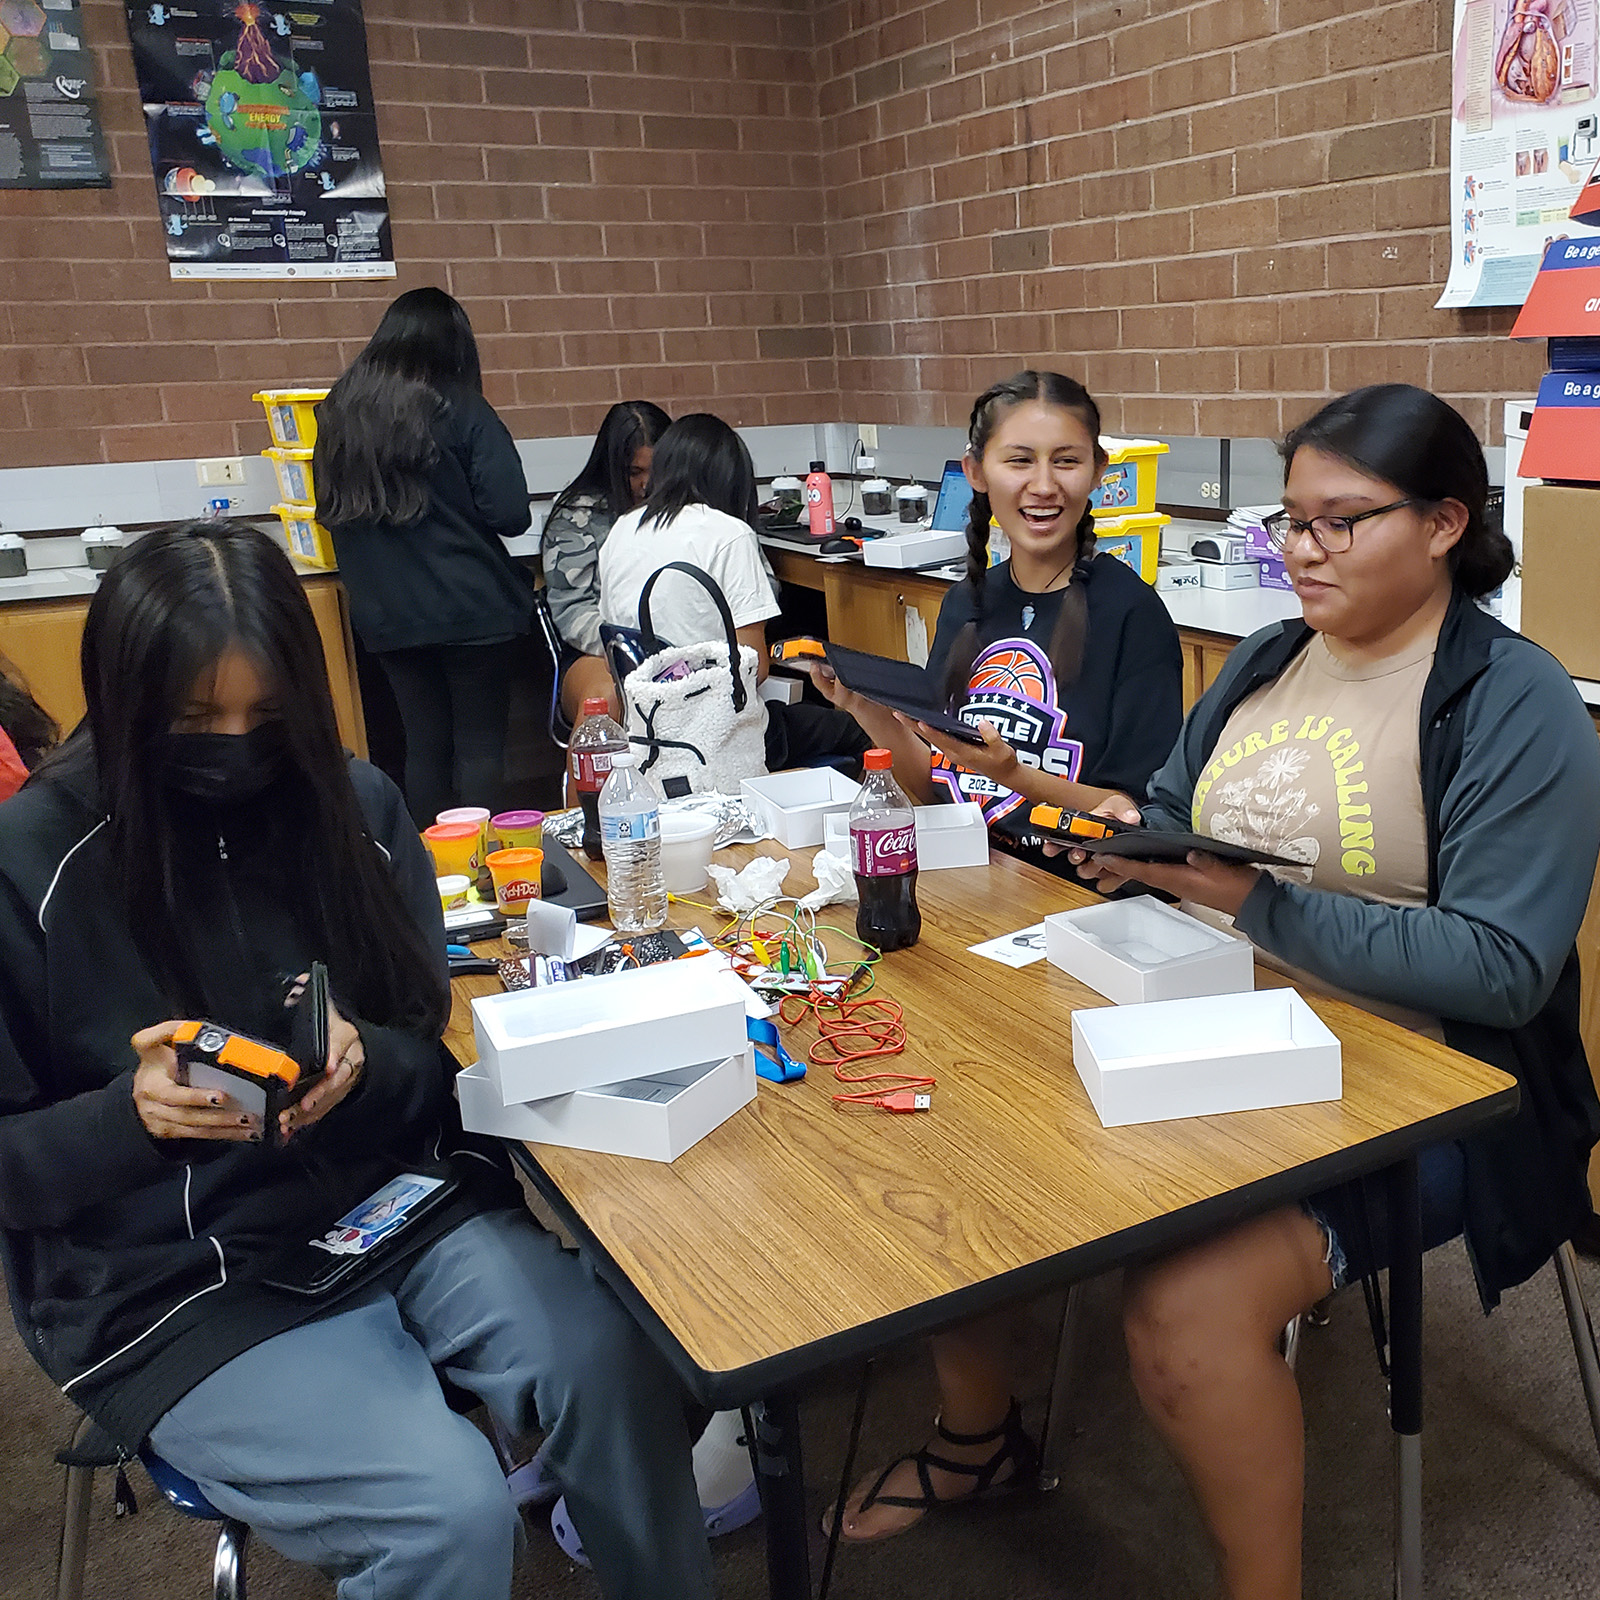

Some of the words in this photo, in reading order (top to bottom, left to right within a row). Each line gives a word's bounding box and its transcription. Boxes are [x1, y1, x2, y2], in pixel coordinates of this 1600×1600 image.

[1564, 245, 1580, 258] Be
[1579, 246, 1588, 257] a
[1563, 382, 1581, 396] Be
[1582, 384, 1592, 395] a
[968, 778, 999, 792] 2023
[1295, 715, 1335, 741] IS
[1325, 728, 1376, 876] CALLING
